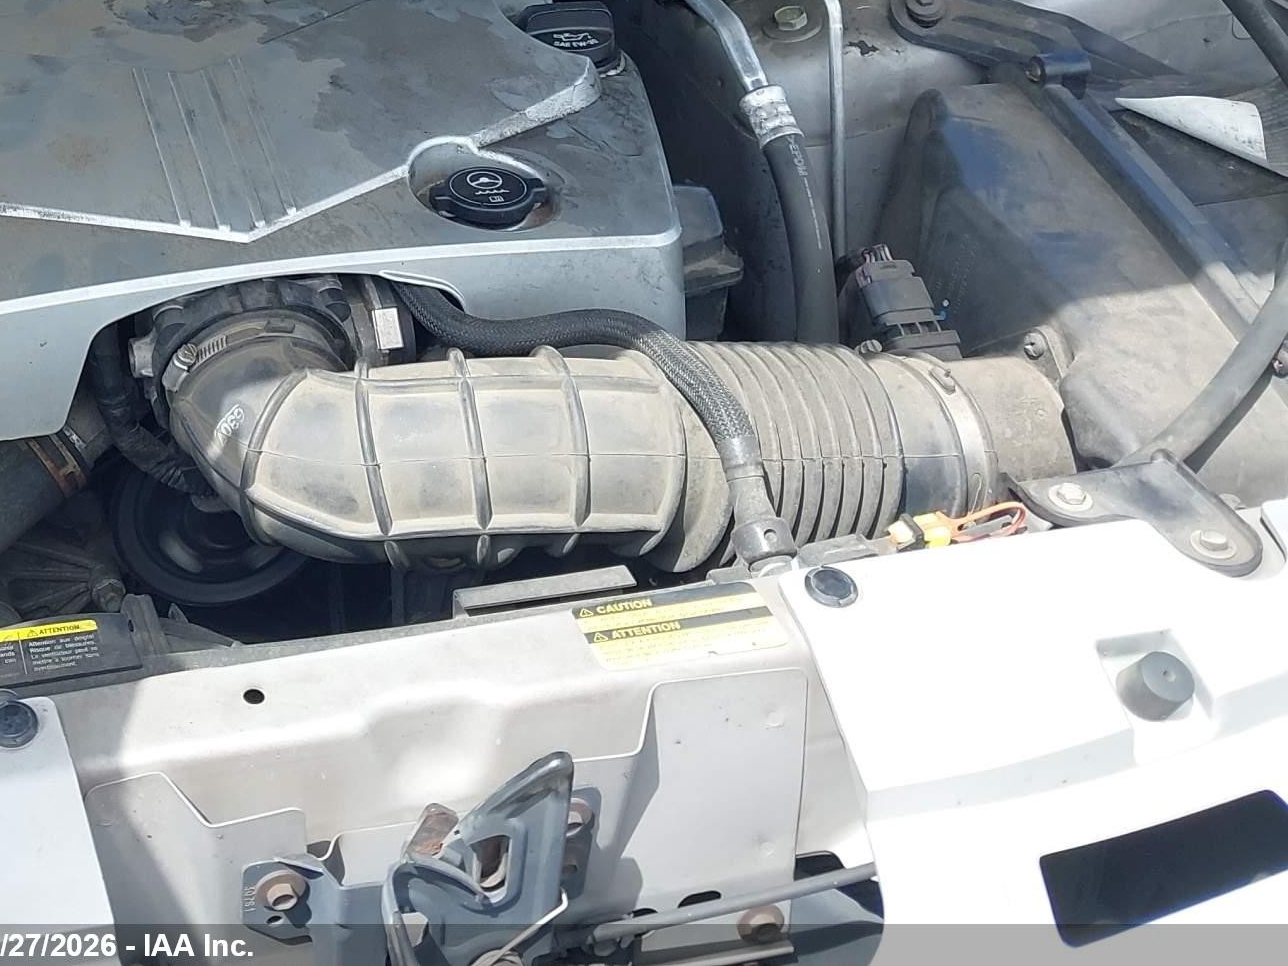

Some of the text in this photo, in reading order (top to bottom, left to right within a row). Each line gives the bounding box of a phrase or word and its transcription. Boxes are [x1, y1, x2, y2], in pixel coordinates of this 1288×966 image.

[596, 598, 652, 615] CAUTION
[39, 624, 80, 635] ATTENTION
[611, 621, 681, 640] ATTENTION
